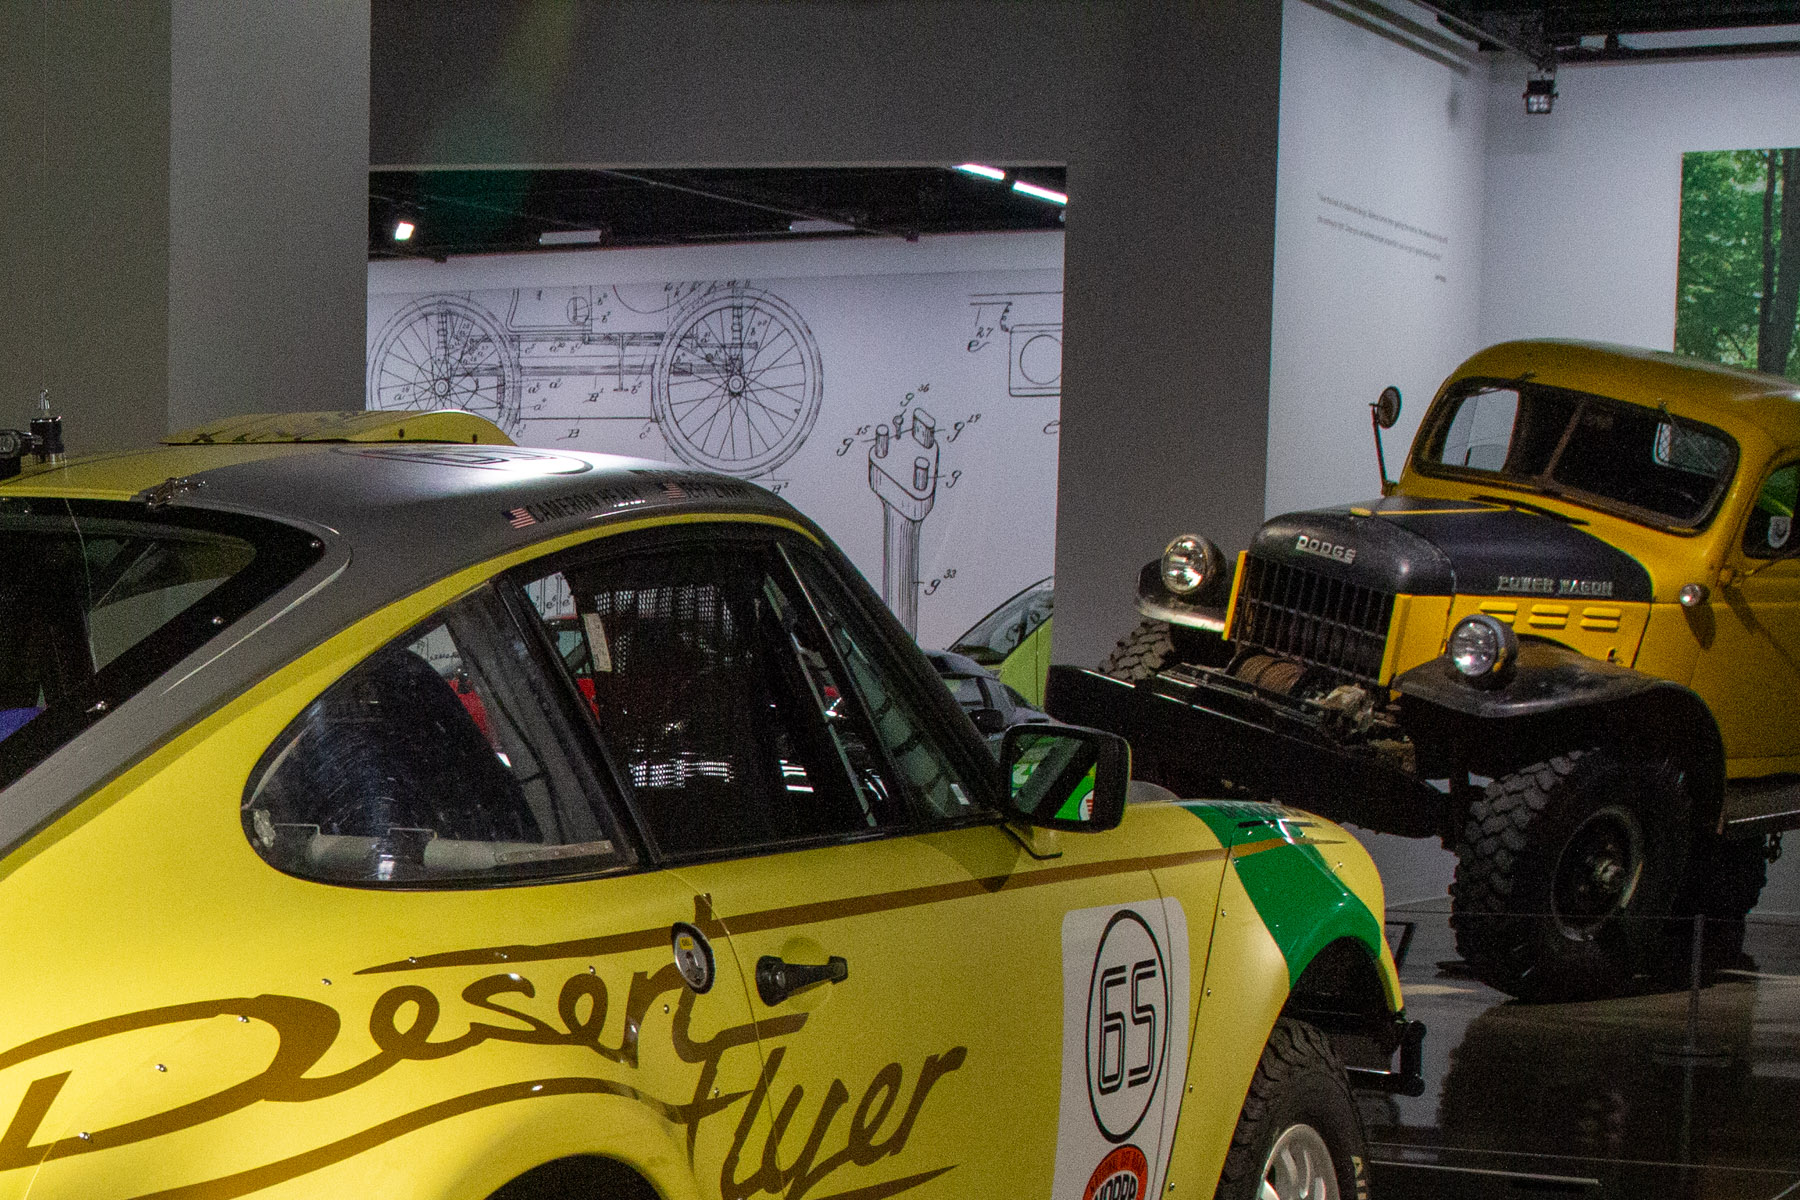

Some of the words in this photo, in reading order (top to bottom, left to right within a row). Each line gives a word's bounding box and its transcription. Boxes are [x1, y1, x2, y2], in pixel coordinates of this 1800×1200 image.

[1296, 535, 1357, 564] DODGE
[1498, 575, 1553, 593] POWER
[1558, 578, 1613, 598] WAGON
[1098, 958, 1157, 1095] 65
